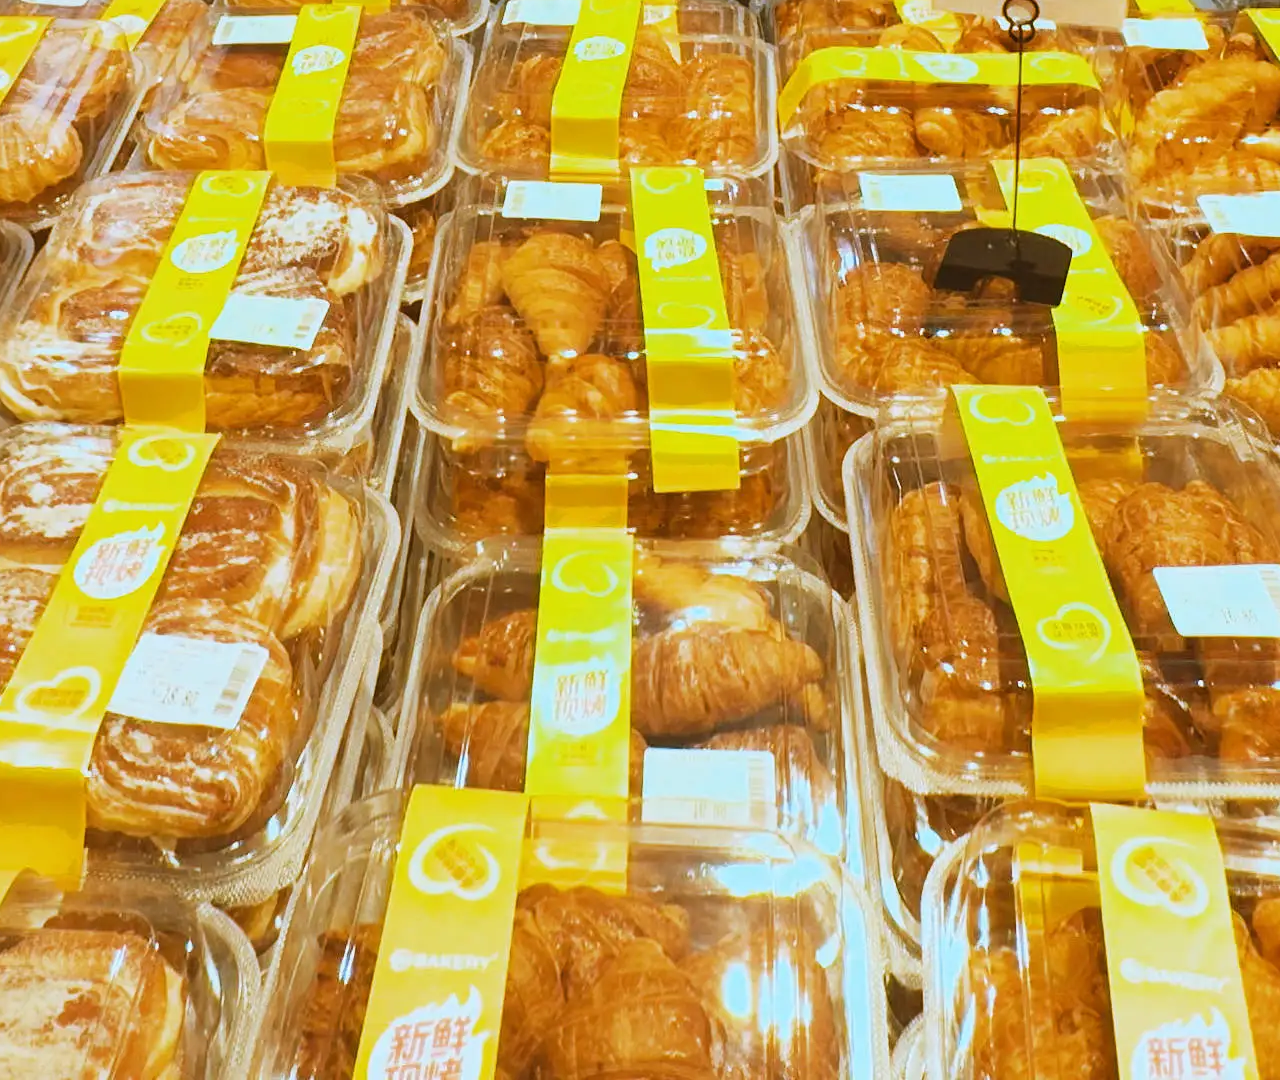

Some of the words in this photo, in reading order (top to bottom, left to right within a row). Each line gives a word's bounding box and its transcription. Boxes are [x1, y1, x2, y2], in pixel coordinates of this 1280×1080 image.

[412, 952, 492, 973] BAKERY
[387, 1015, 471, 1065] 新鲜
[1147, 1036, 1225, 1077] 新鲜
